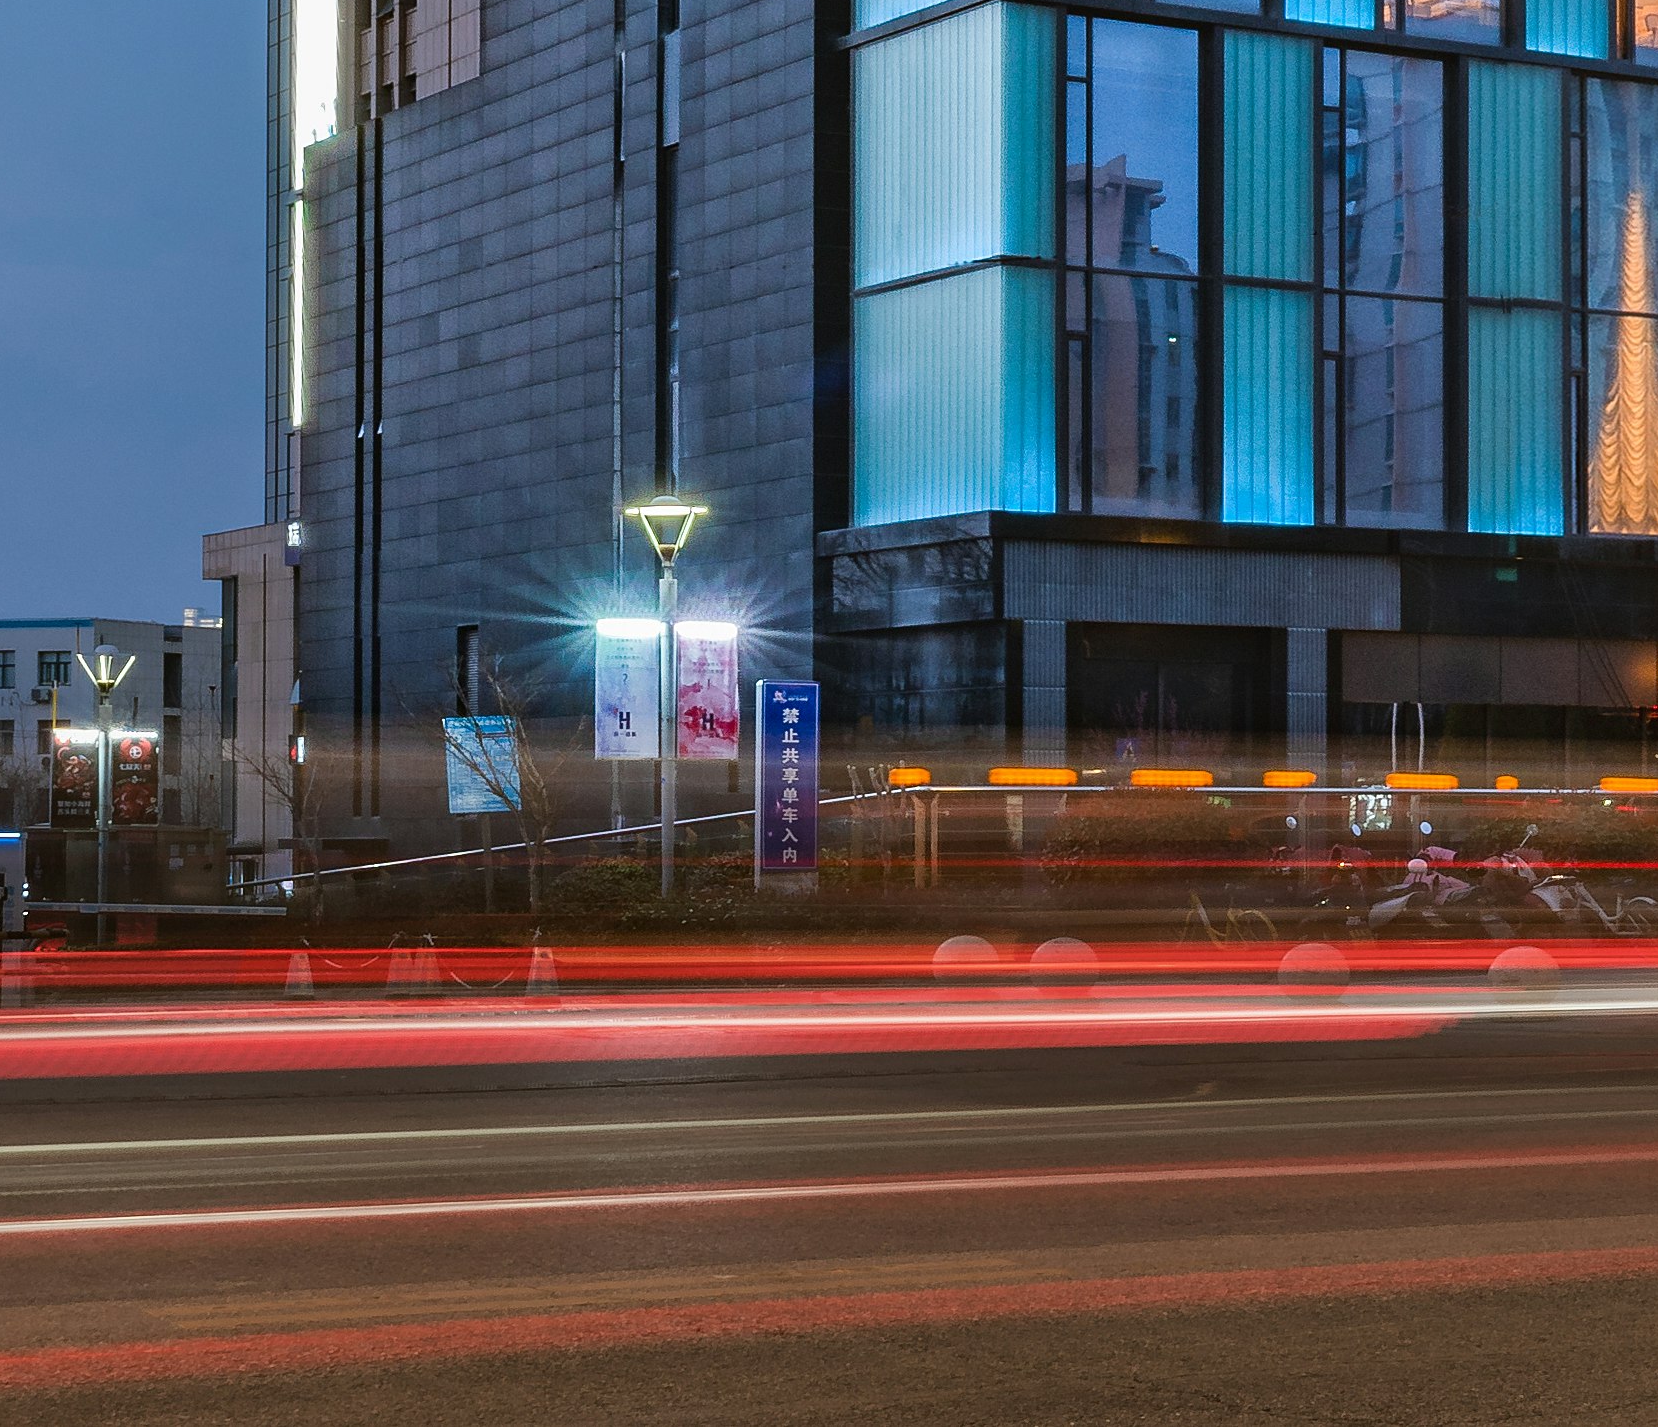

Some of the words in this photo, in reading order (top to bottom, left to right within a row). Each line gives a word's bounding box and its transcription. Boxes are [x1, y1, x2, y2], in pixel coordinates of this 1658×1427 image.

[782, 708, 799, 863] 禁止共享单车入内
